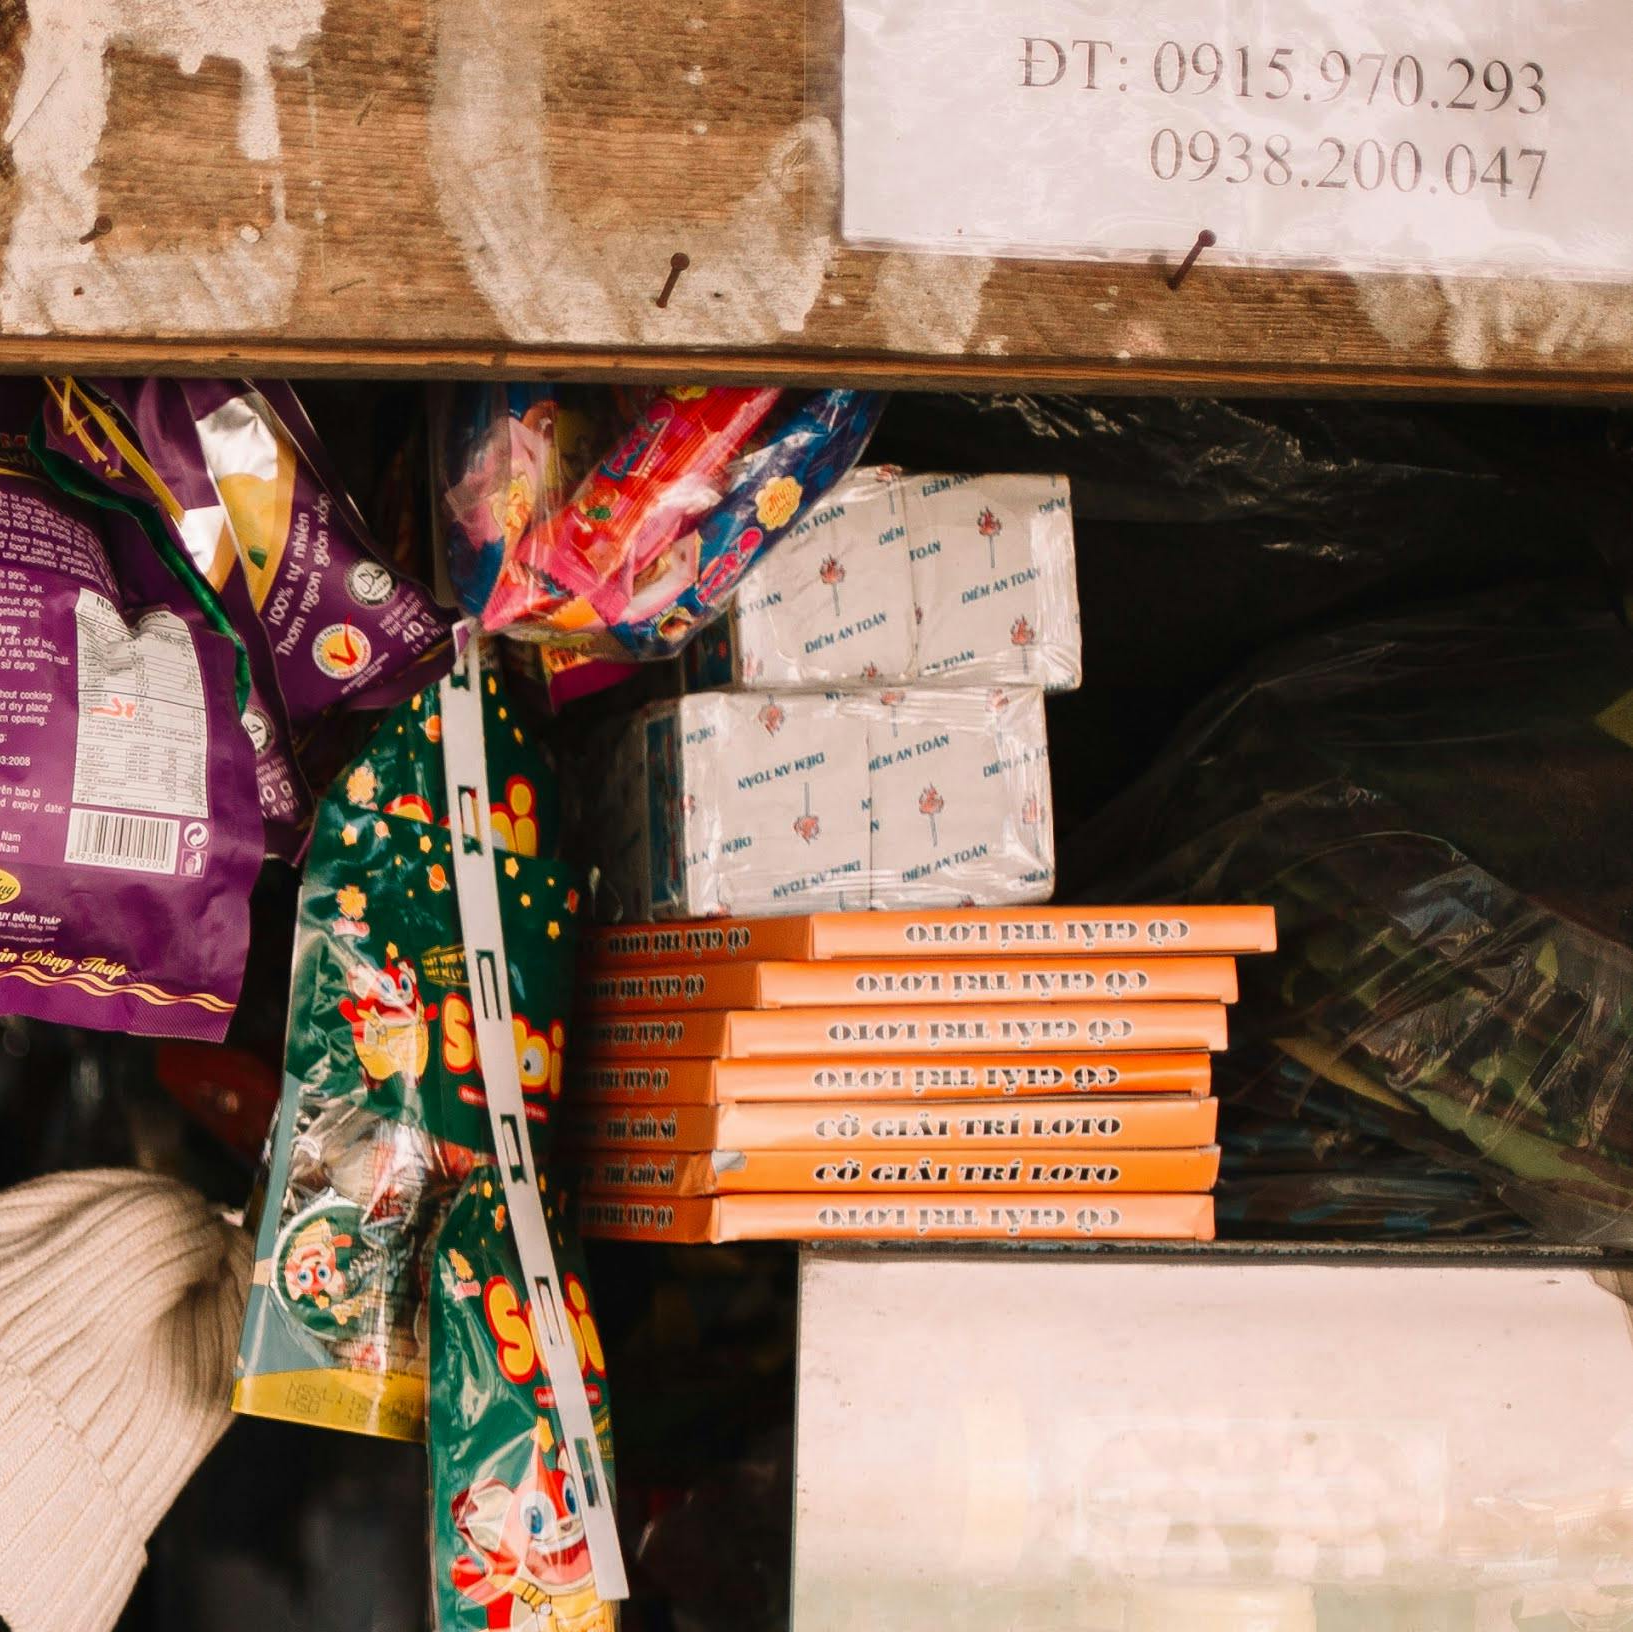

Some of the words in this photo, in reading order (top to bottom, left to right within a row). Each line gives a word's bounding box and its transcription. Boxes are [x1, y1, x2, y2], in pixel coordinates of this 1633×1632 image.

[1018, 36, 1128, 92] ĐT:
[1153, 39, 1548, 116] 0915.970.293
[1149, 127, 1548, 200] 0938.200.047
[299, 571, 323, 614] ngon
[961, 583, 990, 604] DIÊM
[992, 579, 1009, 594] AN
[1009, 567, 1041, 588] TOÀN
[267, 588, 295, 626] 100%
[804, 633, 835, 654] DIÊM
[836, 626, 854, 641] AN
[855, 613, 887, 634] TOÀN
[9, 702, 24, 713] dry
[26, 702, 50, 713] place.
[20, 692, 54, 703] cooking.
[11, 715, 48, 727] opening.
[774, 765, 790, 782] AN
[15, 786, 30, 796] bao
[12, 800, 39, 812] expiry
[44, 803, 66, 815] date:
[1, 831, 21, 843] Nam
[934, 856, 951, 872] AN
[12, 910, 36, 924] ĐỒNG
[905, 922, 989, 943] LOTO
[78, 956, 127, 982] Tháp
[856, 974, 941, 994] LOTO
[442, 993, 565, 1101] Sbi
[1031, 1117, 1122, 1137] LOTO
[1029, 1164, 1120, 1183] LOTO
